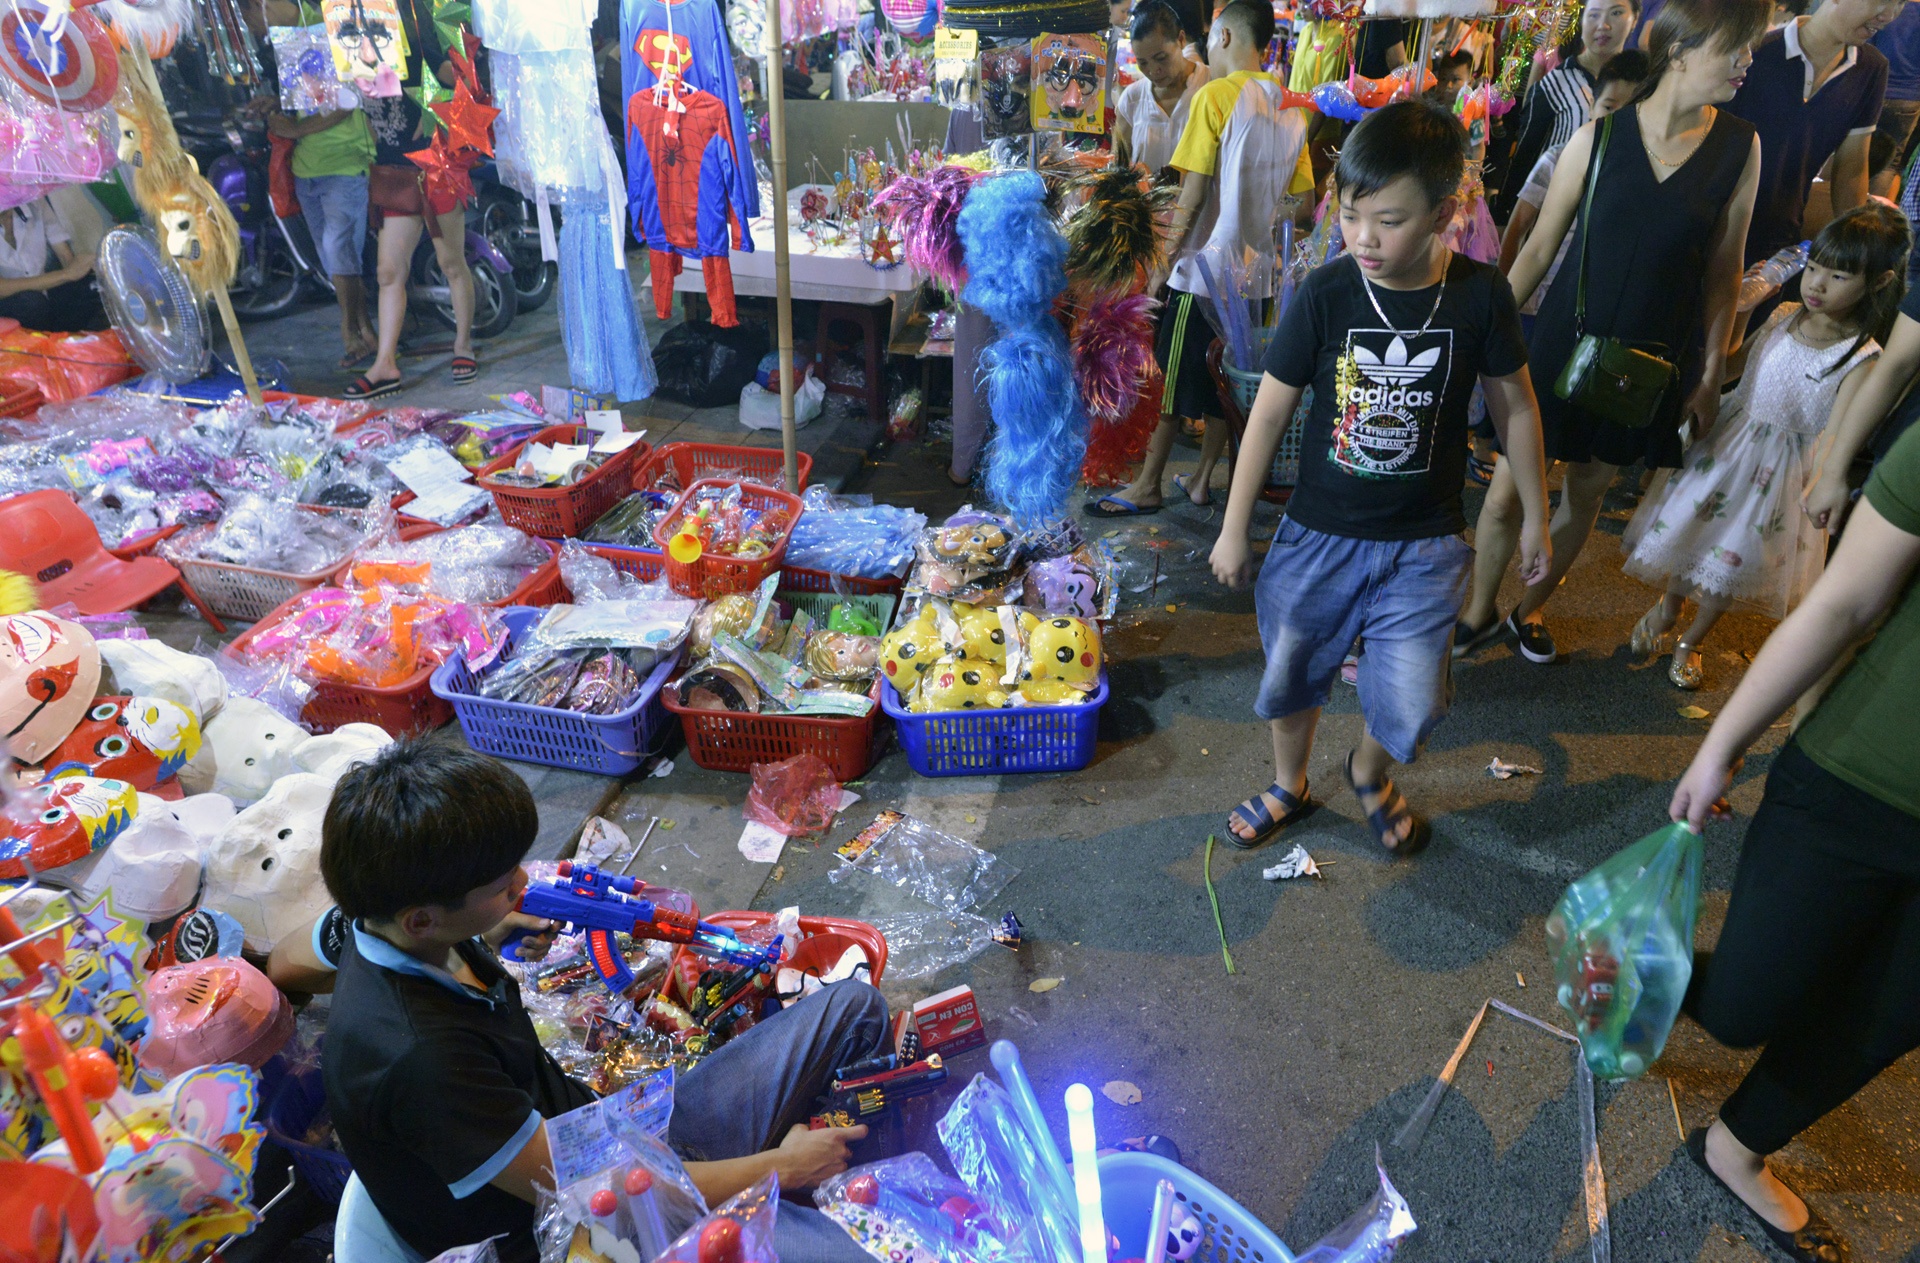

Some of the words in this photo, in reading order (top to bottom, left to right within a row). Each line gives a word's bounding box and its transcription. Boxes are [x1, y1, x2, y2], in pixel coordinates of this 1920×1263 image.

[939, 40, 973, 49] ACCESSORIES
[1349, 386, 1433, 407] adidas
[1356, 404, 1394, 420] MARKE
[1396, 407, 1414, 421] MIT
[1409, 420, 1420, 442] DEN
[1365, 428, 1408, 438] STREIFEN
[1360, 437, 1374, 445] THE
[1376, 440, 1405, 448] BRAND
[1348, 435, 1361, 458] WITH
[1360, 457, 1376, 470] THE
[1385, 443, 1418, 470] STRIPES
[954, 1002, 974, 1015] CON
